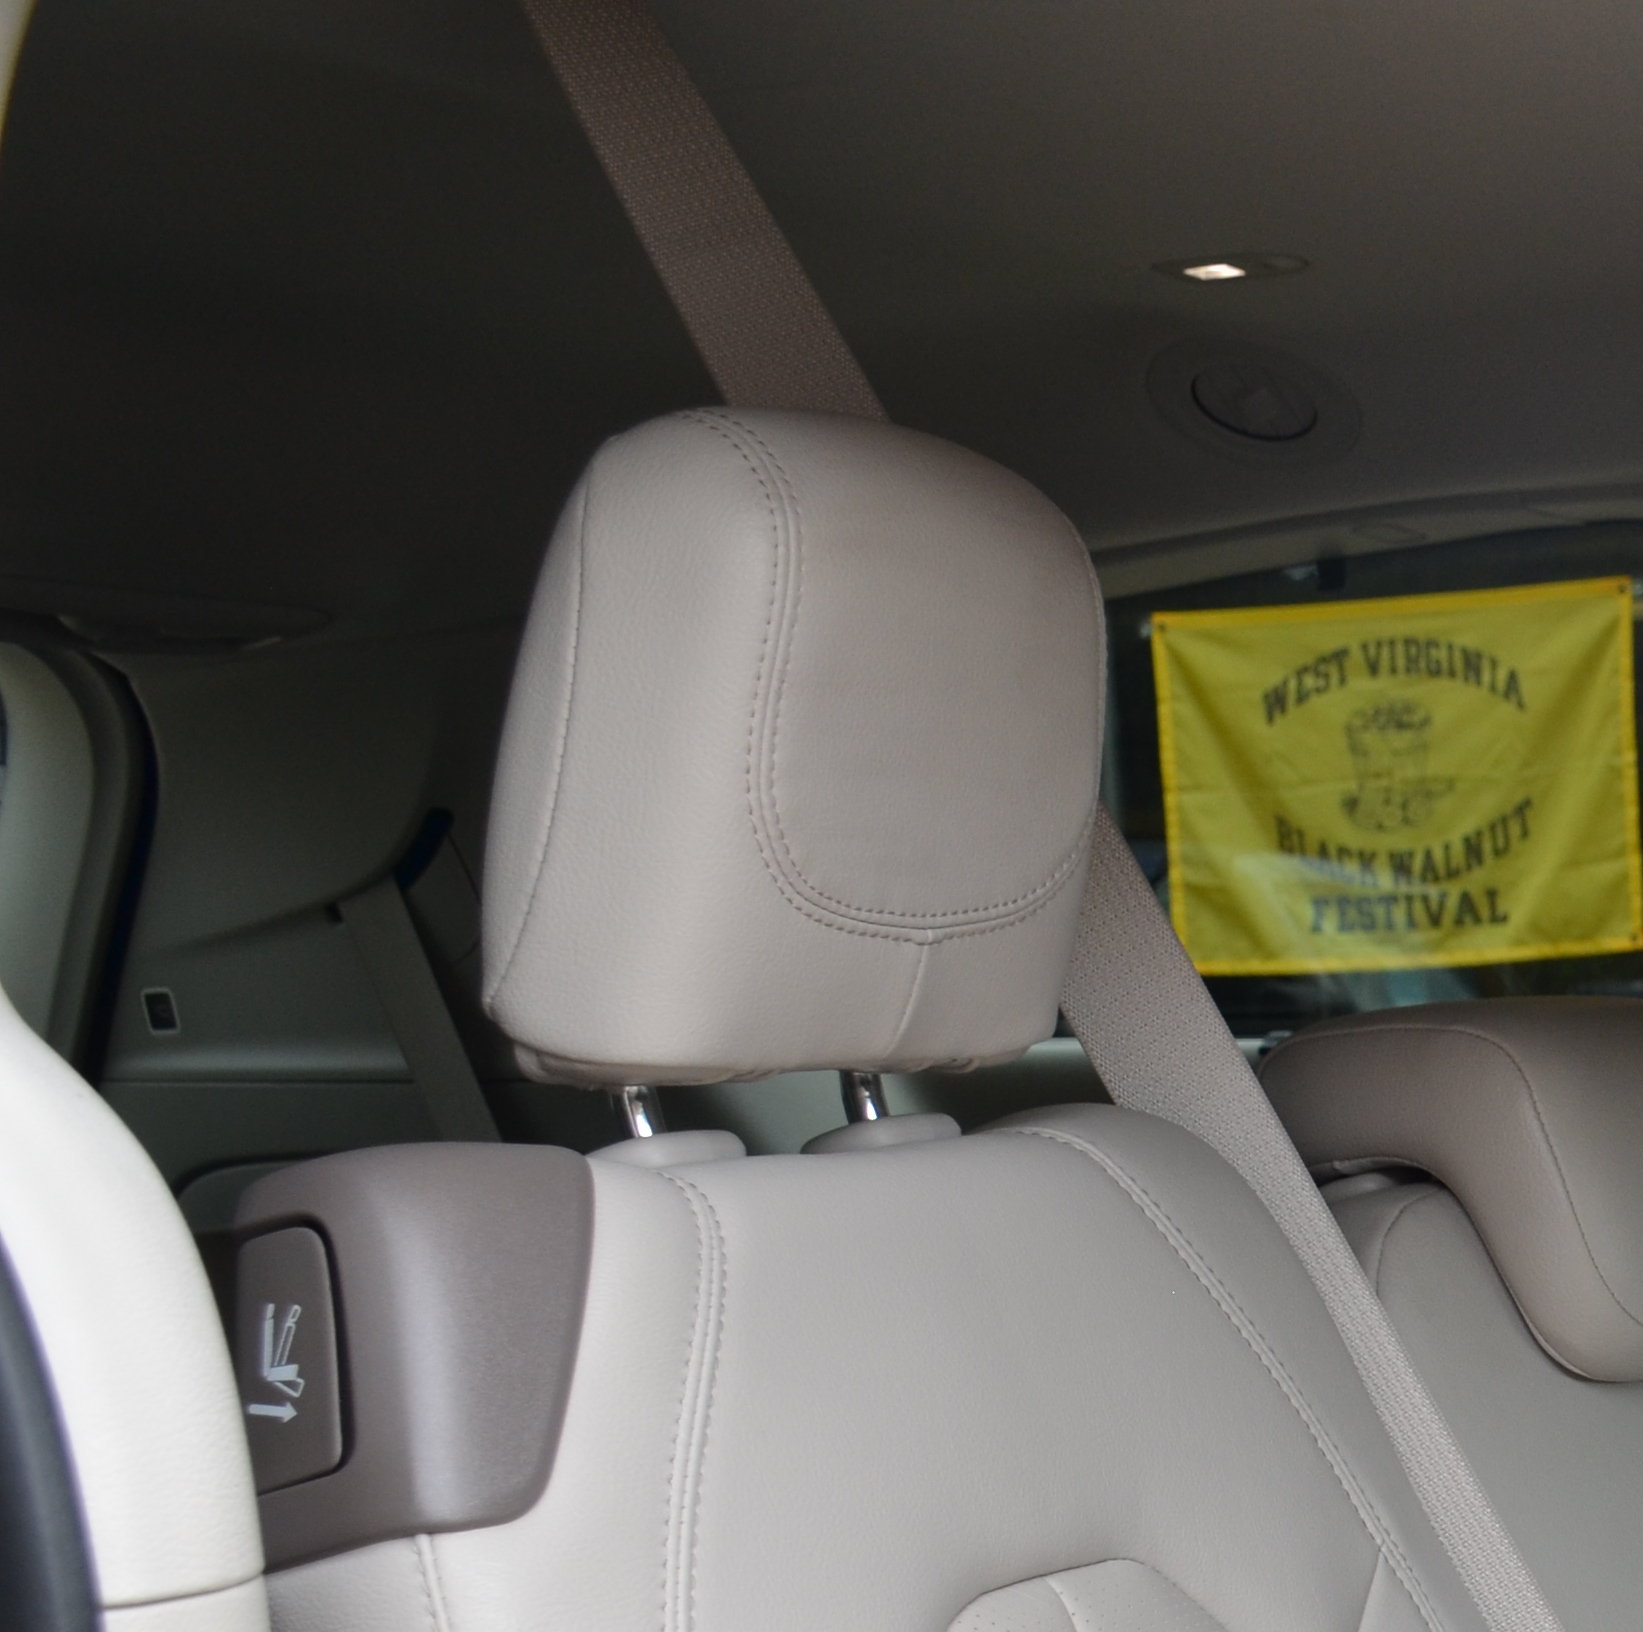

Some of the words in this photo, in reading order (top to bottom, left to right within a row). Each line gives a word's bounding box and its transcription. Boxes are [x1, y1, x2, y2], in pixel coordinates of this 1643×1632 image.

[1262, 644, 1350, 727] WEST
[1360, 635, 1526, 711] VIRGINIA
[1274, 813, 1379, 889] BLACK
[1388, 797, 1532, 886] WALNUT
[1309, 887, 1509, 934] FESTIVAL
